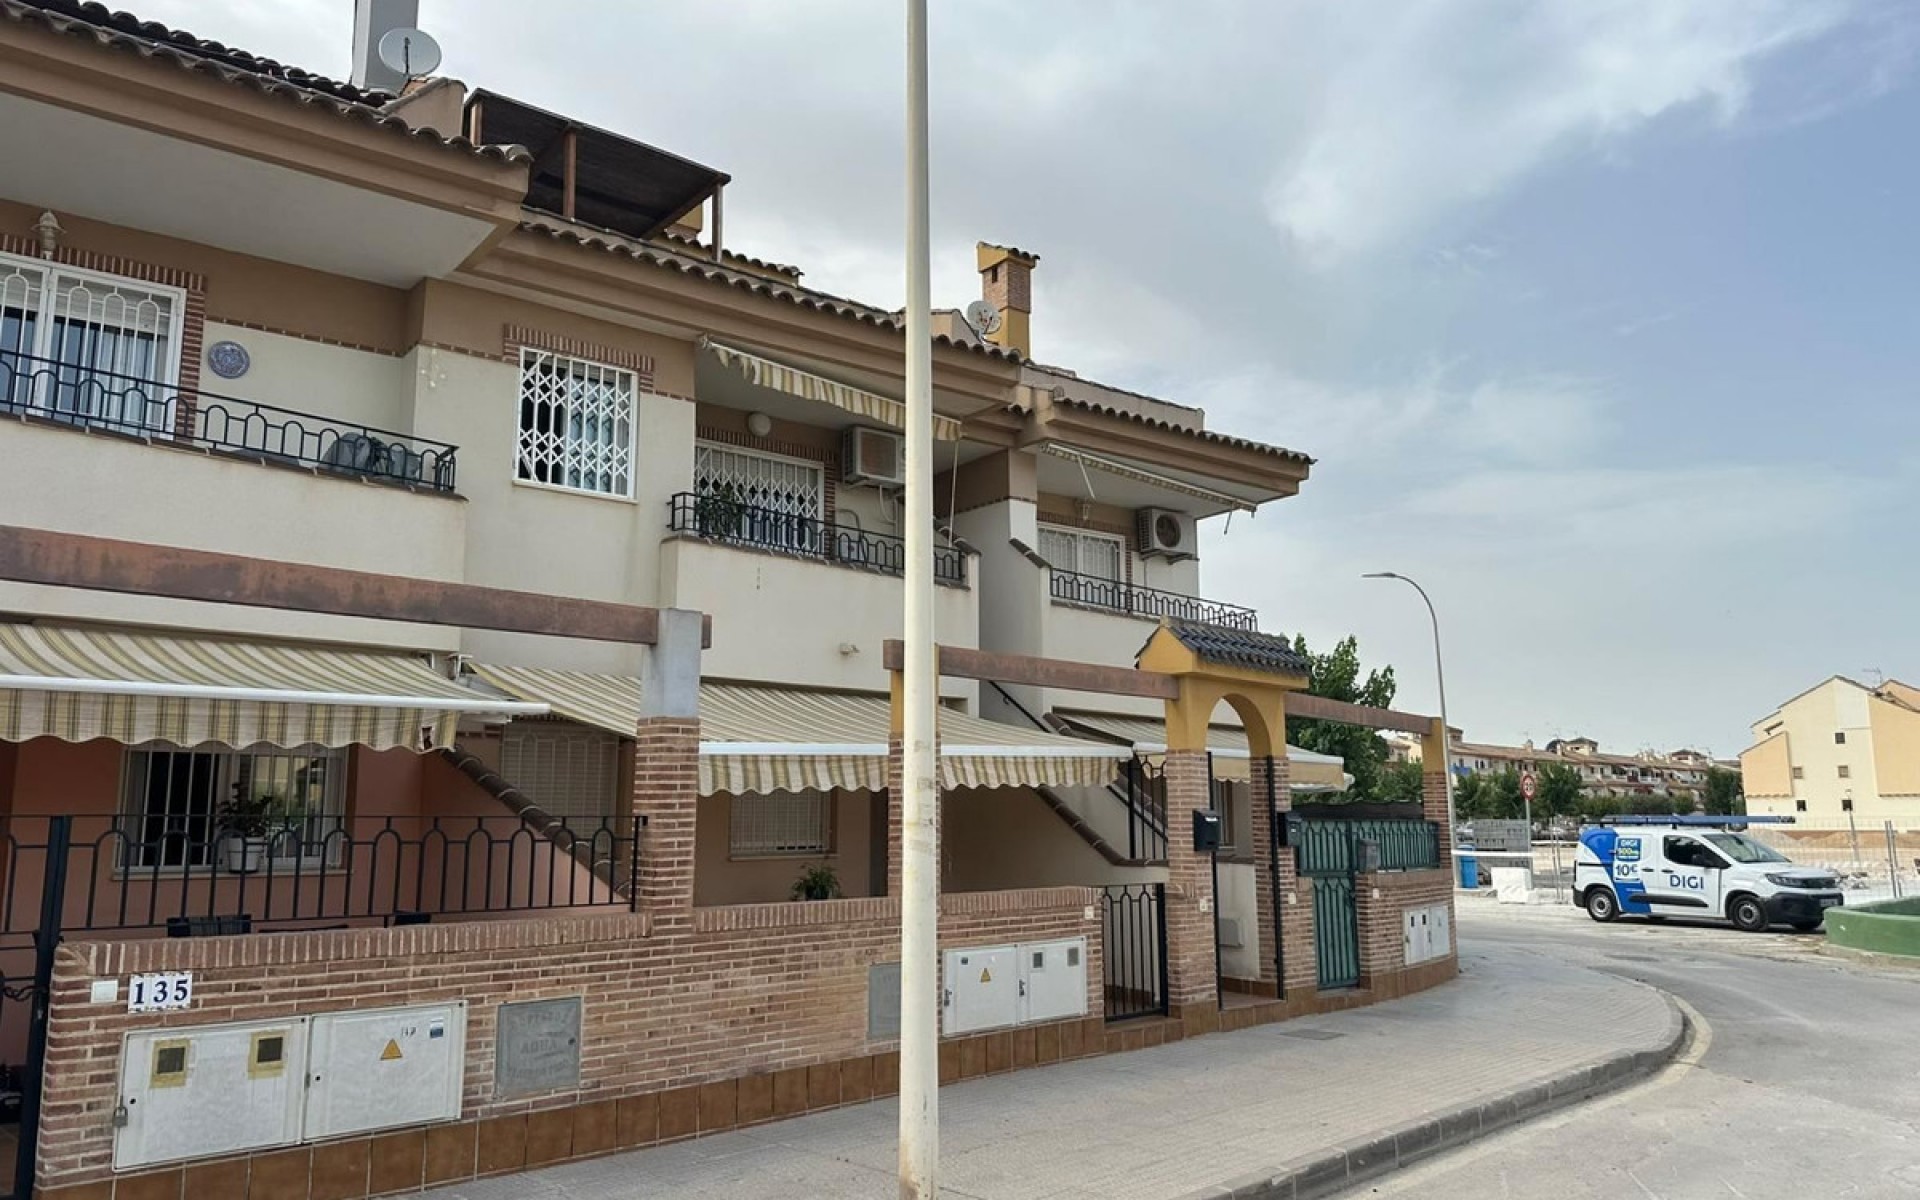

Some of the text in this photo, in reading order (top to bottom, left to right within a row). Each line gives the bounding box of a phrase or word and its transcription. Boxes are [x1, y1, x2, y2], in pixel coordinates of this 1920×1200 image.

[1615, 863, 1638, 877] 10€
[1669, 874, 1704, 890] DIGI
[133, 979, 188, 1006] 135
